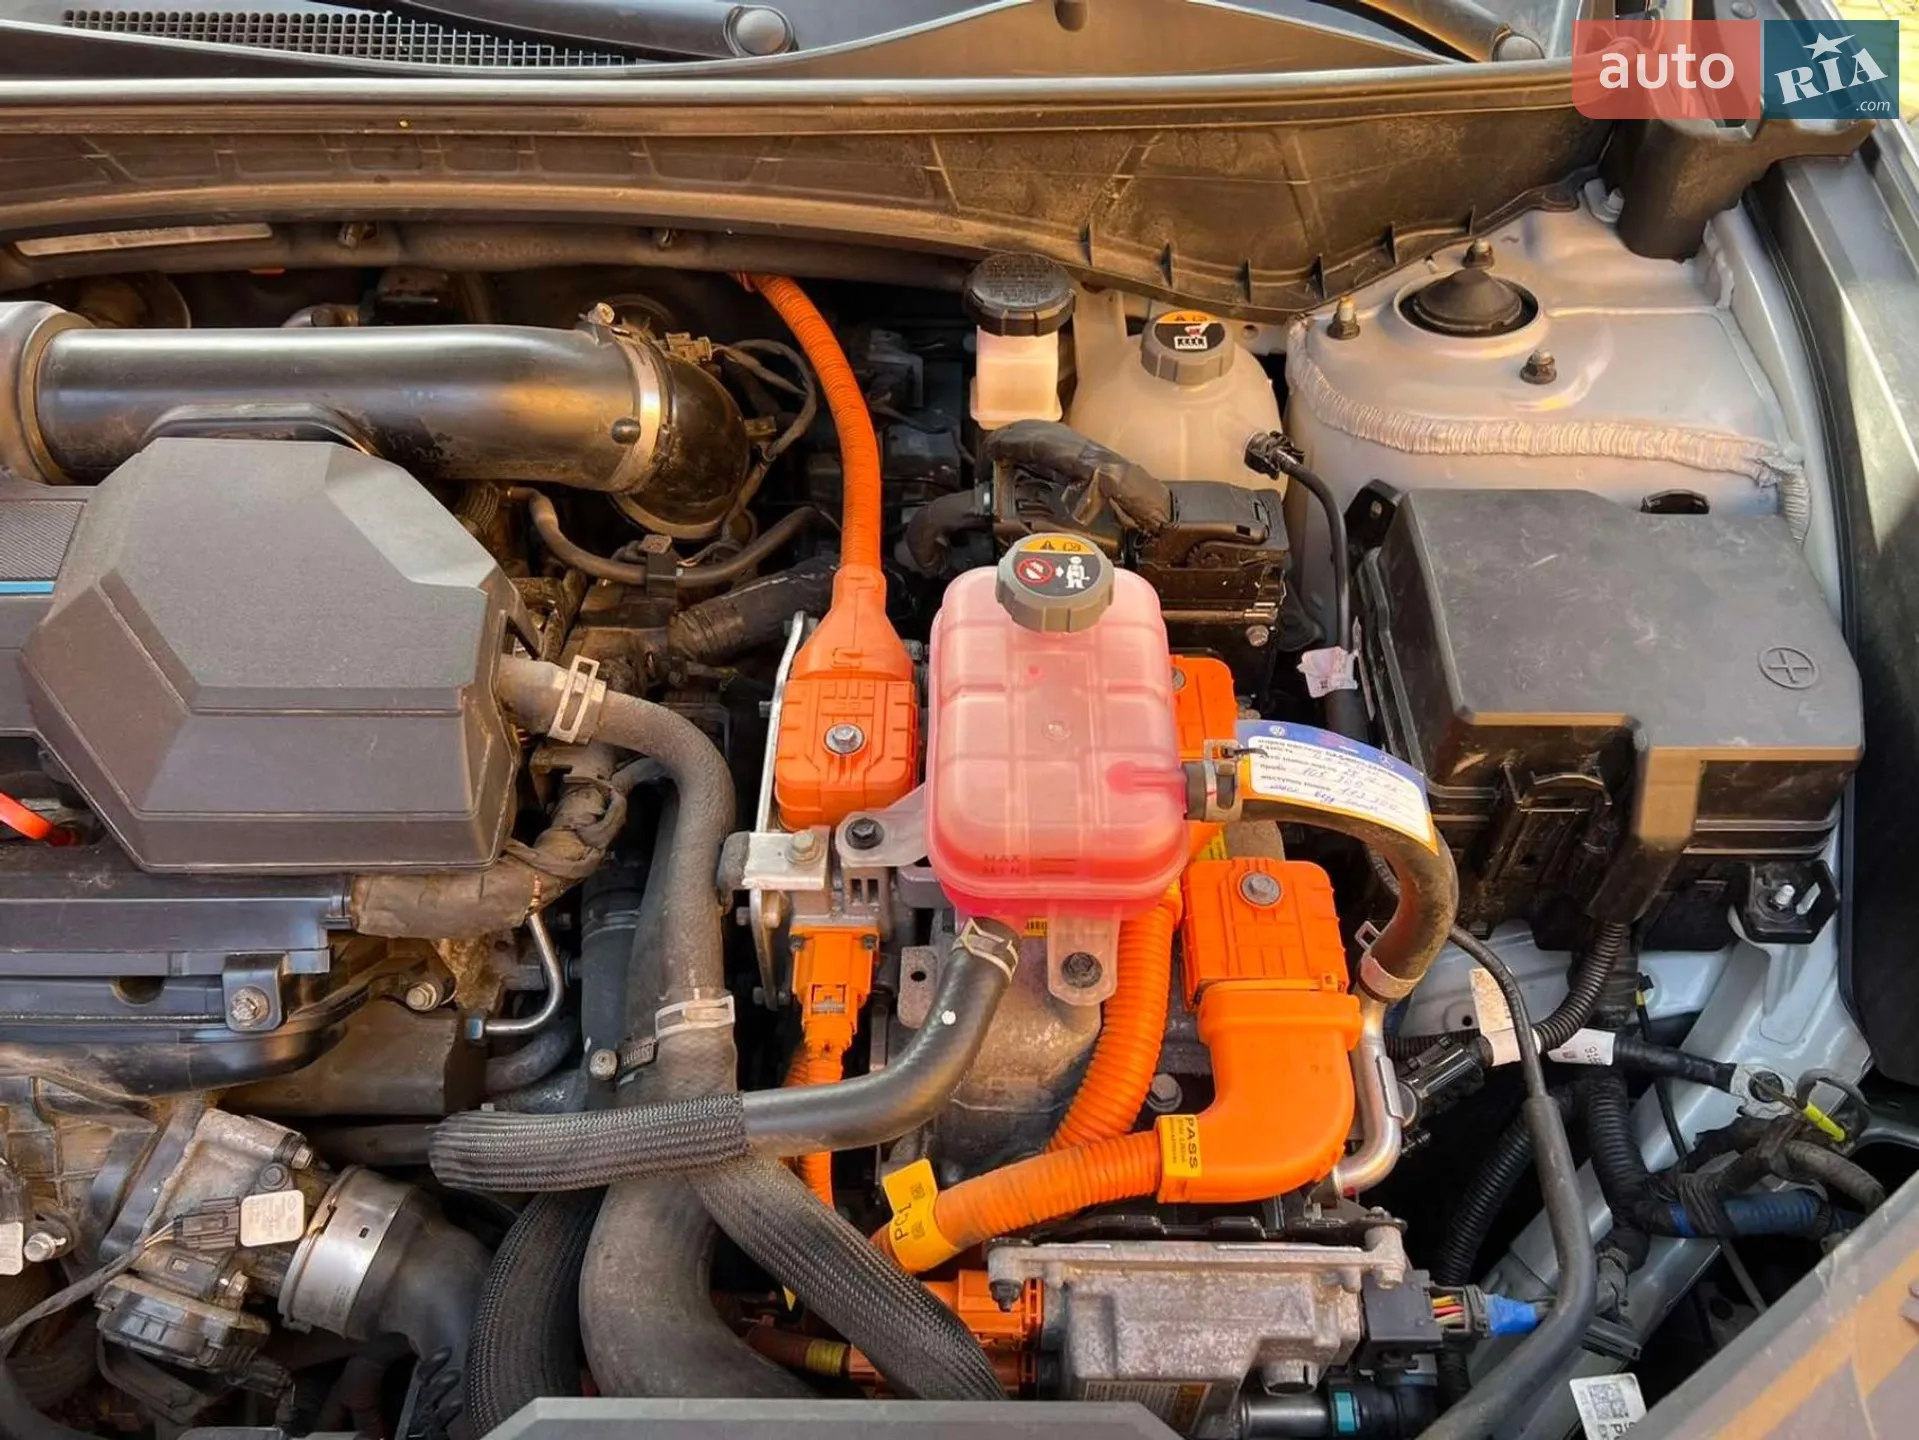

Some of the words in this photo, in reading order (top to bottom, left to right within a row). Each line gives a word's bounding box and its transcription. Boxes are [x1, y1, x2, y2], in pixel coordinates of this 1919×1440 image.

[983, 852, 1021, 864] MAX
[982, 864, 1021, 876] MIN
[1184, 1115, 1199, 1169] PASS
